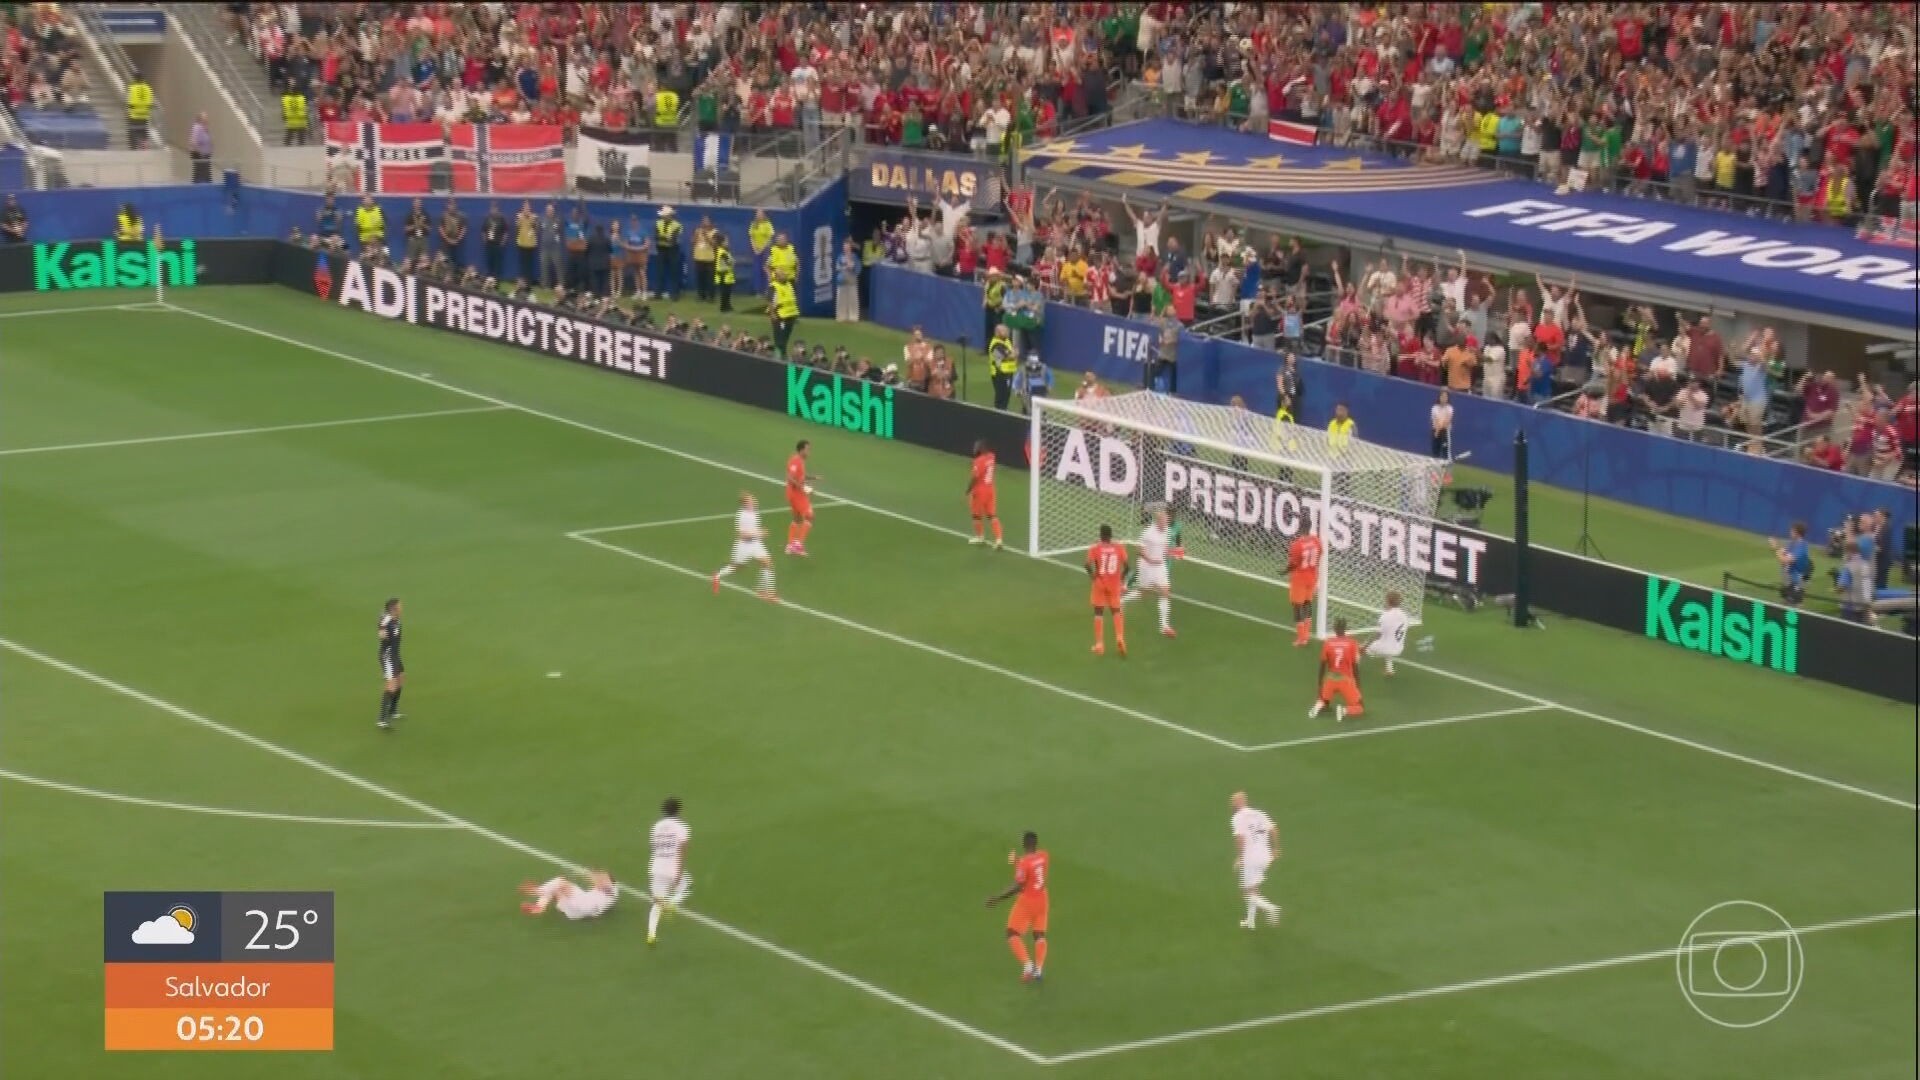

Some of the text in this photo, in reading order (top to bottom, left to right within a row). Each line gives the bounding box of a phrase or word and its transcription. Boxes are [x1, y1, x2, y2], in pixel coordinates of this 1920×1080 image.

[871, 161, 977, 197] DALLAS
[1463, 199, 1677, 245] FIFA
[32, 238, 198, 291] Kalshi
[339, 260, 673, 379] ADI PREDICTSTREET
[1103, 325, 1150, 362] FIFA
[787, 362, 895, 440] Kalshi
[1645, 573, 1800, 674] Kalshi
